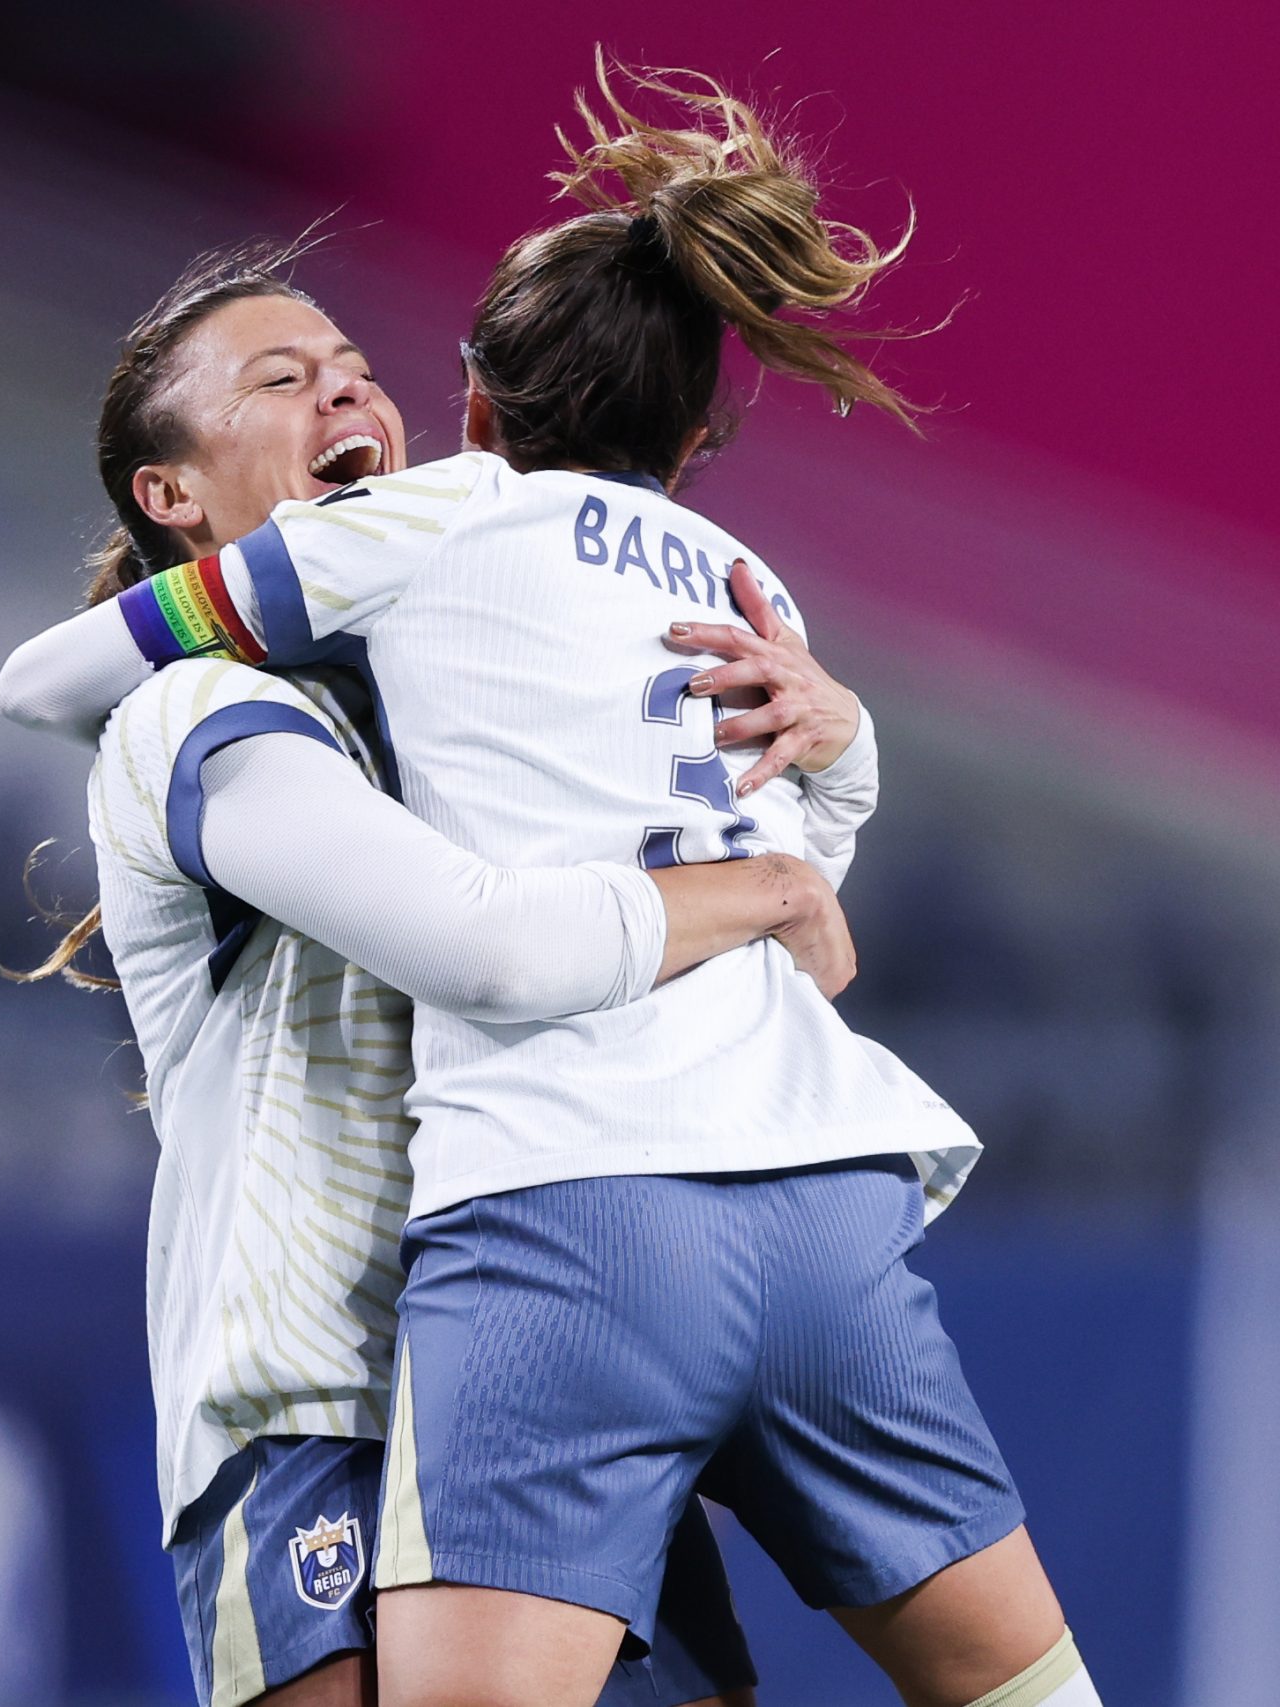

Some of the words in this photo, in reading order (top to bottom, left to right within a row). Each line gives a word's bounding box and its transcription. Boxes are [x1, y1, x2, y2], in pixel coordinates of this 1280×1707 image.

[574, 494, 791, 620] BARN
[175, 586, 184, 595] IS
[178, 595, 197, 622] LOVE
[195, 591, 214, 618] LOVE
[163, 602, 180, 626] LOVE
[176, 629, 187, 639] IS
[192, 623, 204, 633] IS
[314, 1569, 351, 1595] REIGN
[328, 1587, 341, 1599] FC
